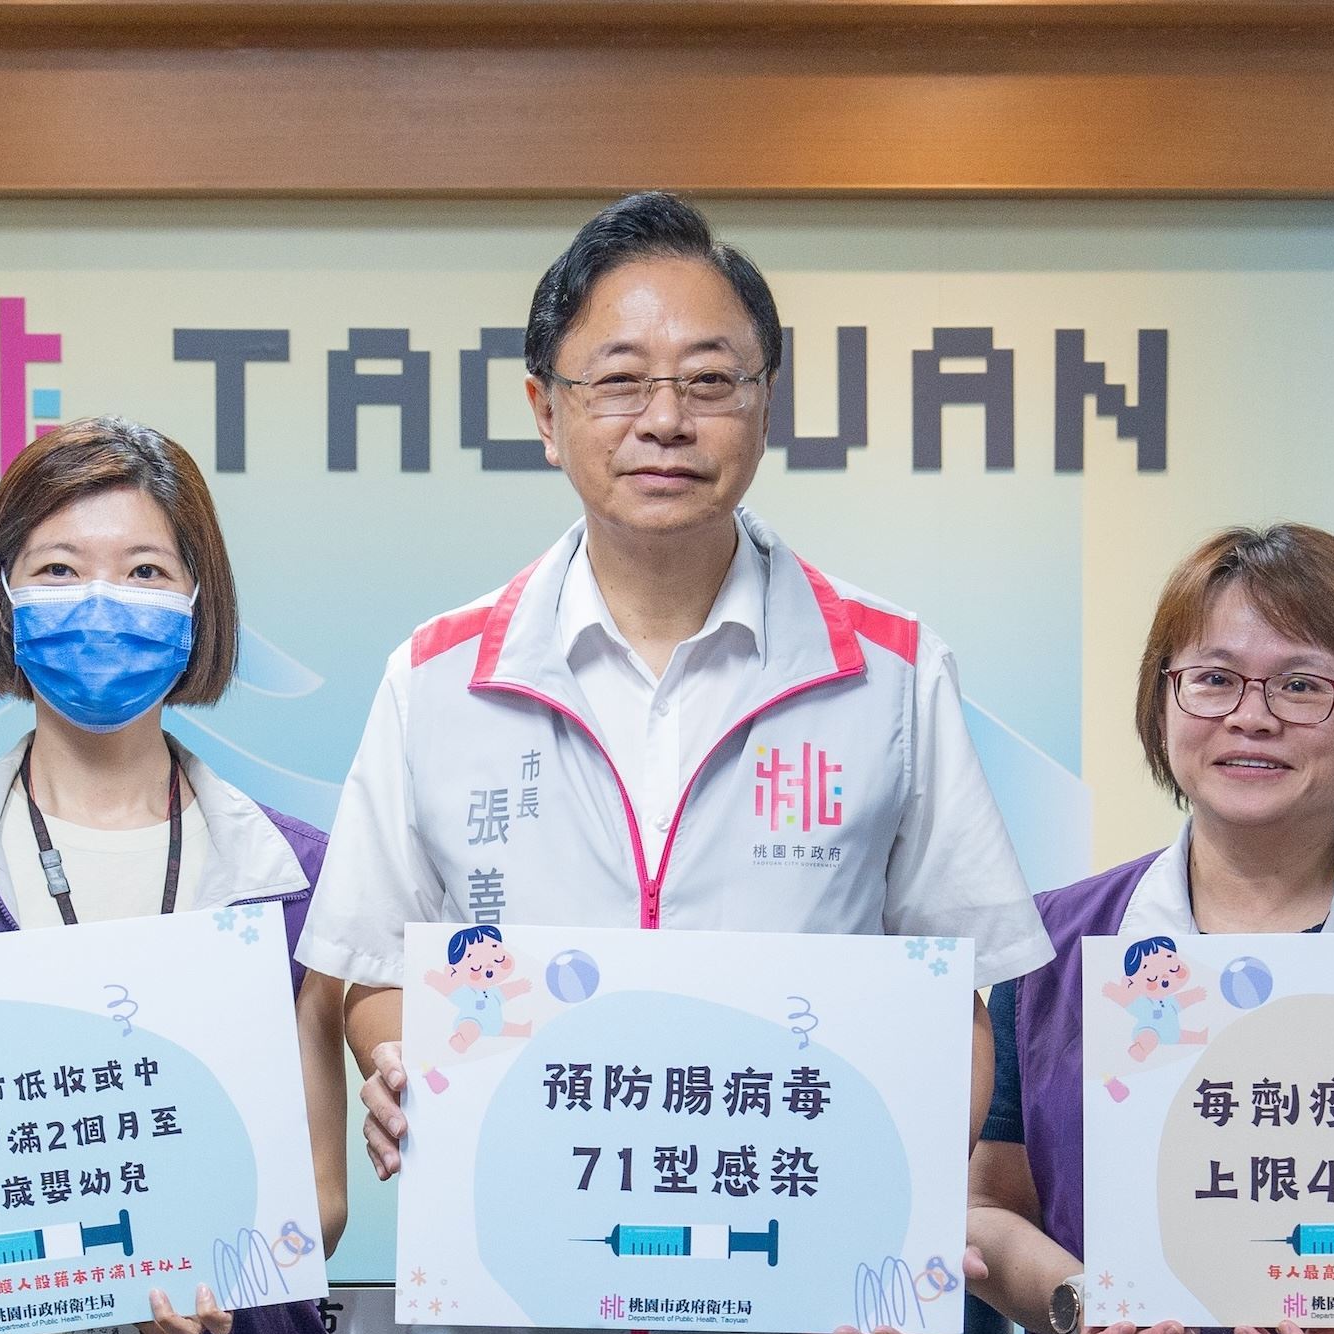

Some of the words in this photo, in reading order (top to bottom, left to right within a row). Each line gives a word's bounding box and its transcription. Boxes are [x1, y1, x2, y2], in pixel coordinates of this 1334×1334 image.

[173, 326, 1167, 473] TAOUAN
[516, 749, 541, 819] 市長
[467, 786, 510, 925] 張善
[753, 843, 842, 861] 桃園市政府
[543, 1062, 832, 1120] 預防腸病毒
[571, 1144, 820, 1198] 71型感染
[40, 1318, 59, 1327] Public
[86, 1311, 114, 1321] Taoyuan
[628, 1315, 665, 1323] Department
[675, 1315, 693, 1323] Public
[721, 1316, 748, 1325] Taoyuan
[629, 1297, 752, 1316] 桃園市政府衛生局
